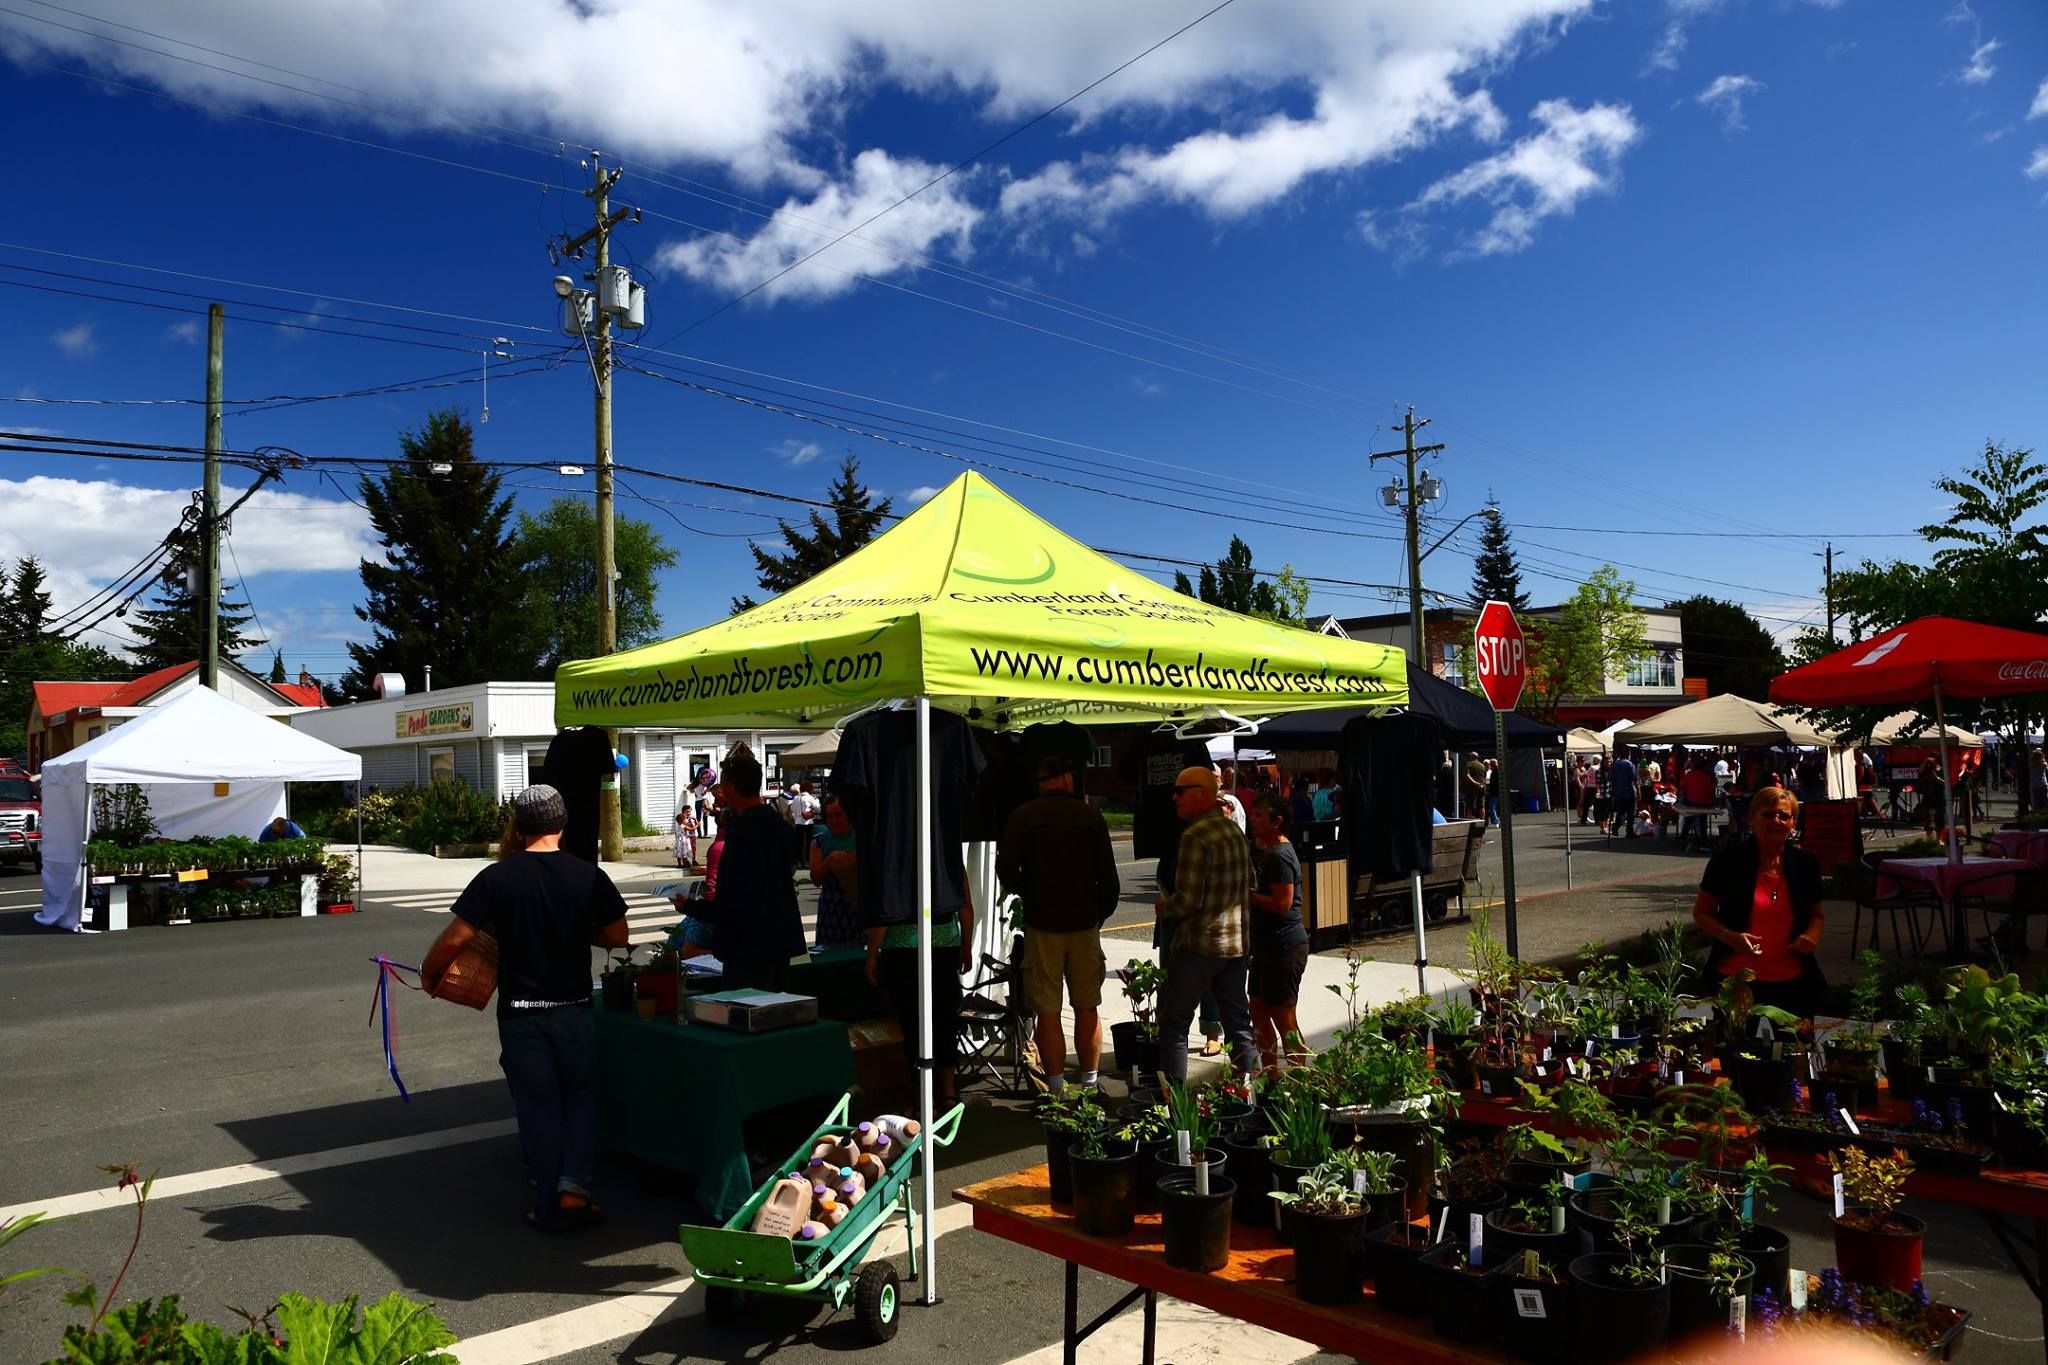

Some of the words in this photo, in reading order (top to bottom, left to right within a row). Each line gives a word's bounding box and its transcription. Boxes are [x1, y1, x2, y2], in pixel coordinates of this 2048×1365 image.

[950, 591, 1119, 604] Cumberland
[1044, 605, 1131, 617] Forest
[1129, 606, 1216, 627] Society
[971, 648, 1387, 693] www.cumberlandforest.com
[1478, 635, 1522, 676] STOP
[572, 650, 882, 712] www.cumberlandforest.com
[408, 709, 428, 736] Panda
[429, 707, 461, 726] GARDENS
